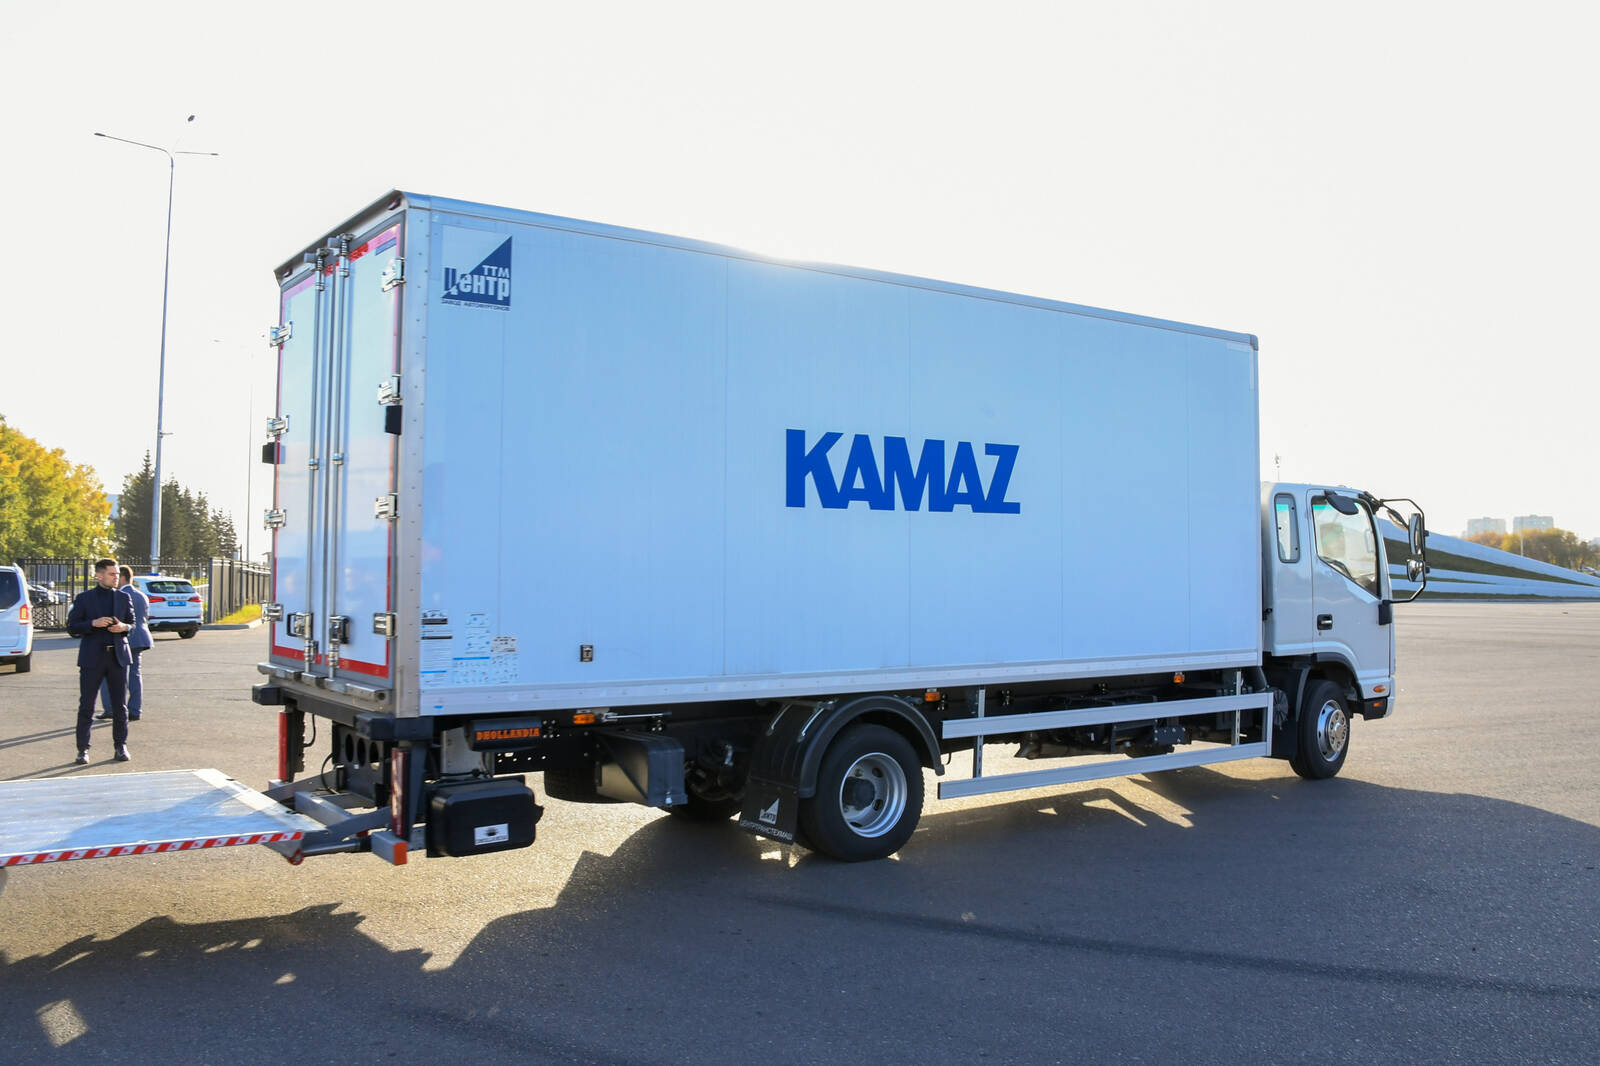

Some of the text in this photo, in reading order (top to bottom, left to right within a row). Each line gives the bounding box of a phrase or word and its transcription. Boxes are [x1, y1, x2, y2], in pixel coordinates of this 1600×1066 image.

[482, 265, 509, 278] ТТМ
[444, 267, 510, 300] Центр
[786, 429, 1020, 514] KAMAZ
[476, 727, 540, 741] DHOLLANDIA
